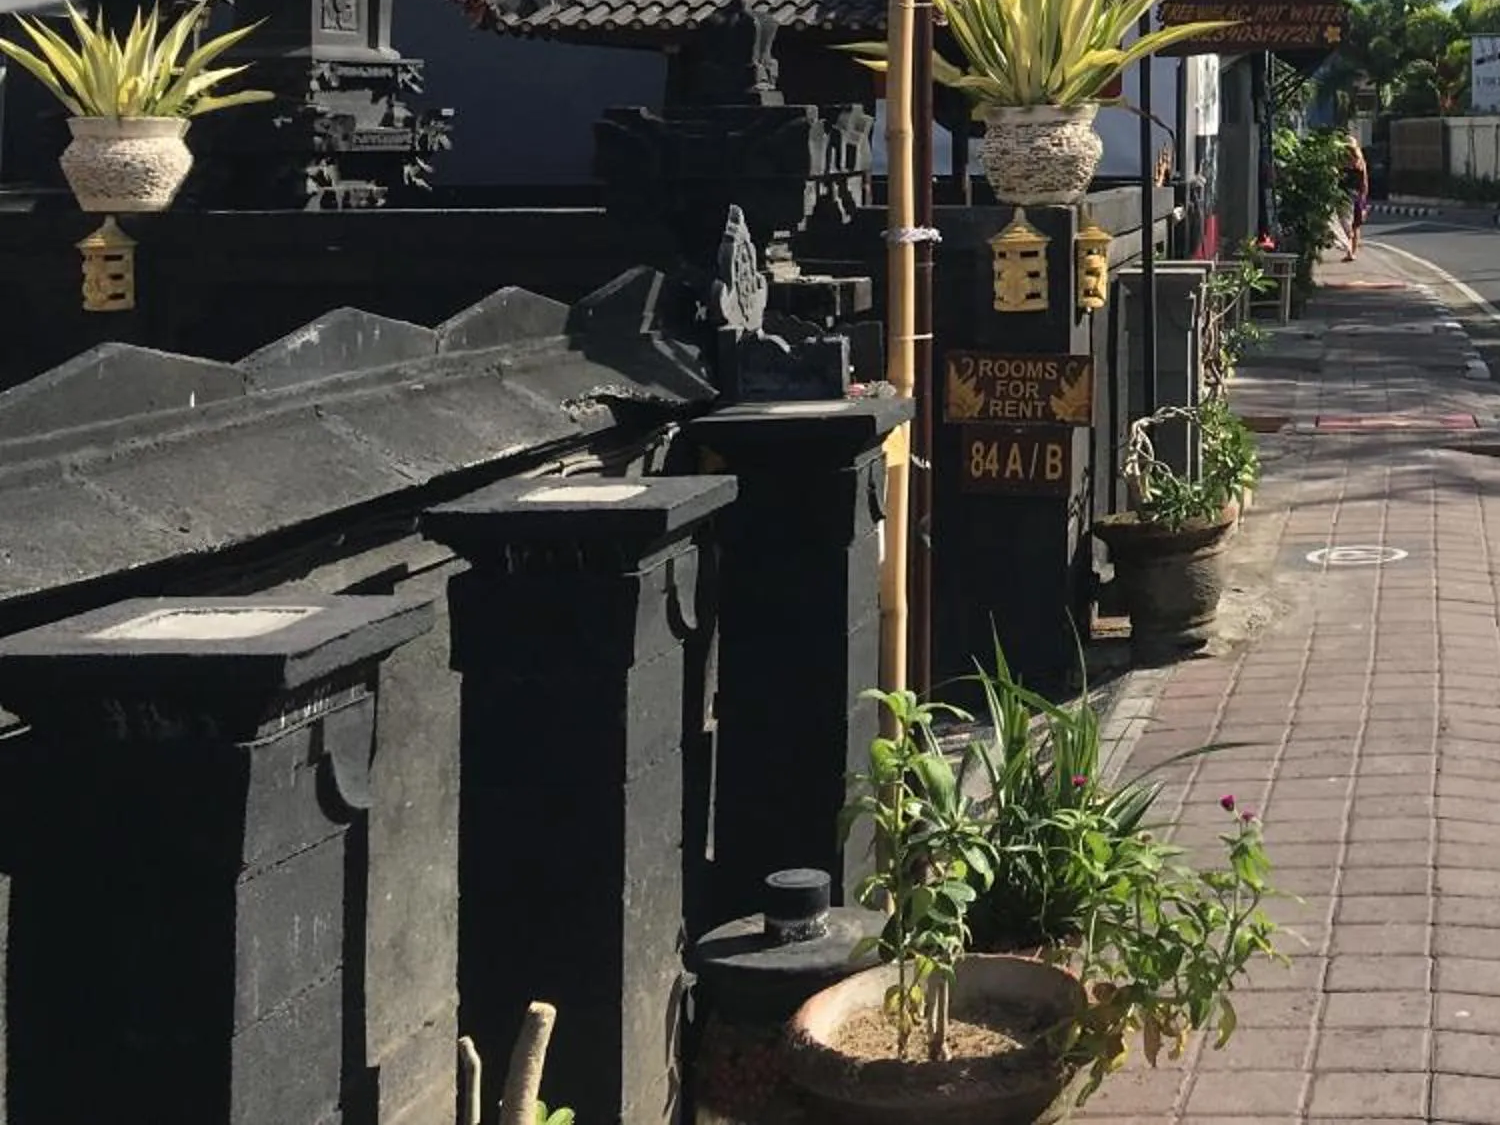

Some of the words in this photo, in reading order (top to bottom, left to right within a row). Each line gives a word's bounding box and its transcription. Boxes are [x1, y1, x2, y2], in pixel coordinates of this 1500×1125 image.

[978, 360, 1058, 380] ROOMS
[995, 380, 1040, 399] FOR
[988, 398, 1047, 418] RENT
